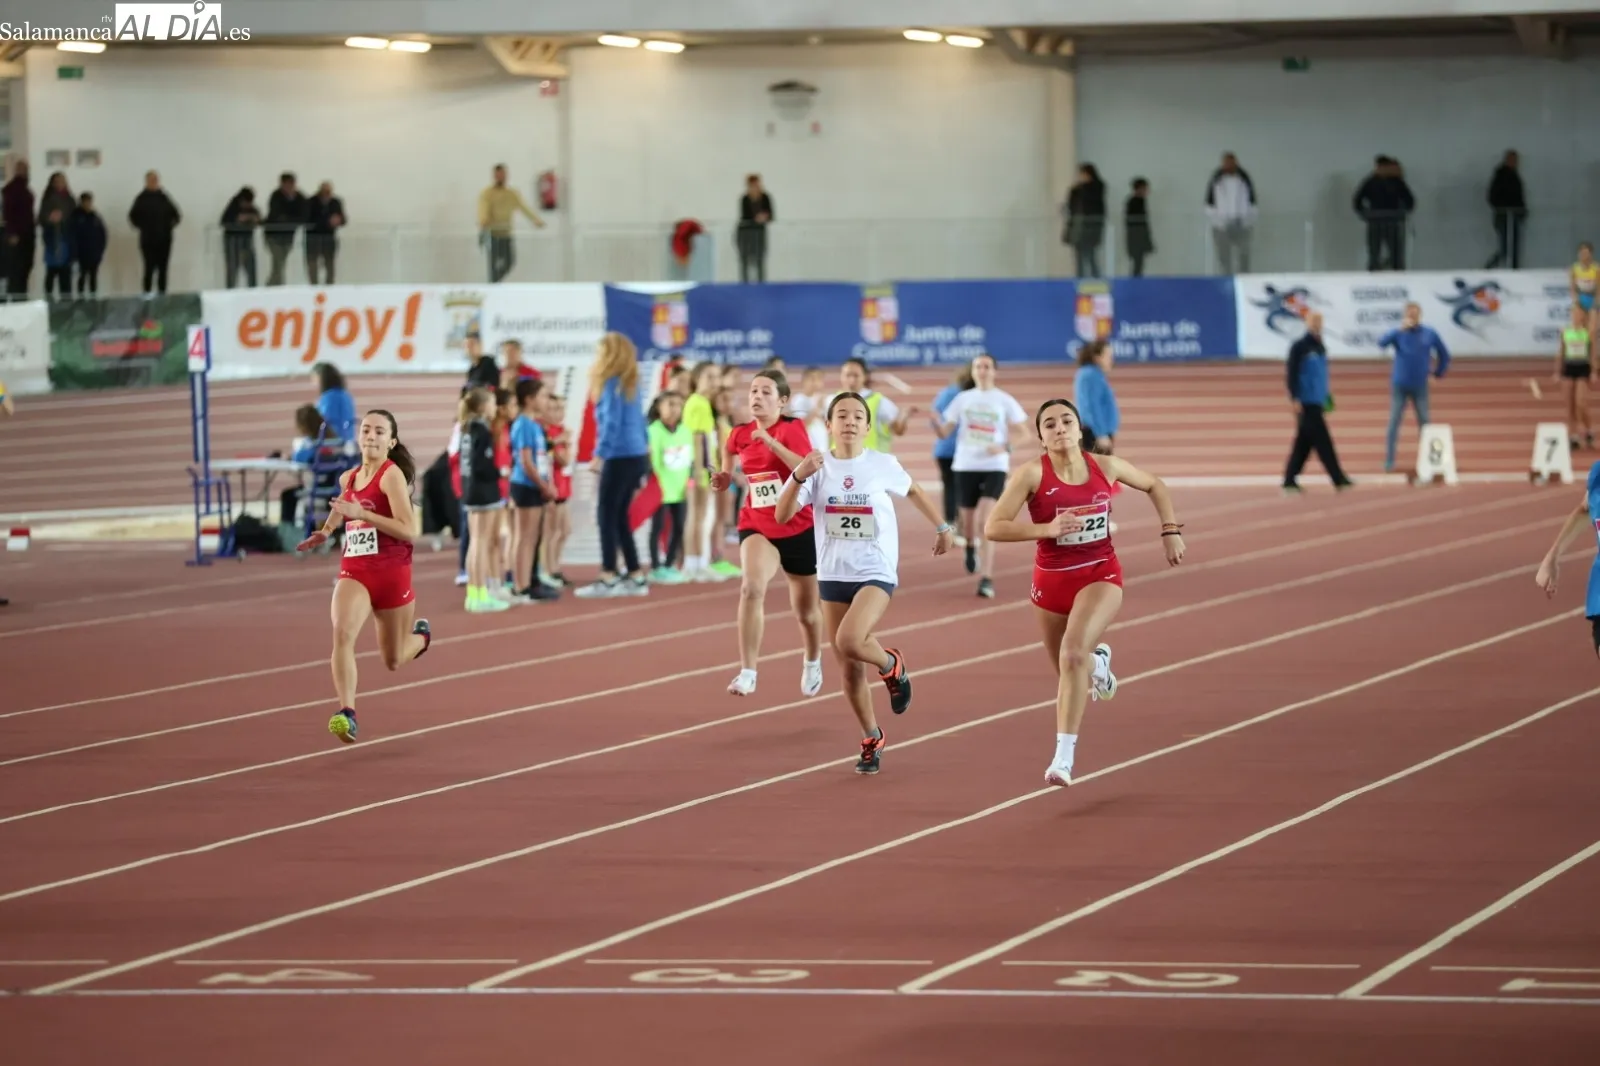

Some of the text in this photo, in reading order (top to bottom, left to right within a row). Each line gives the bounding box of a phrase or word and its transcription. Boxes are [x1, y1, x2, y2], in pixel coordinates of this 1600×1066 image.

[237, 292, 423, 362] enjoy!
[904, 324, 987, 343] Junta de
[1117, 318, 1201, 338] Junta de
[188, 328, 206, 357] 4
[694, 328, 774, 347] Junta de
[1153, 339, 1202, 358] León
[1544, 437, 1558, 464] 7
[755, 484, 777, 498] 601
[840, 516, 861, 529] 26
[348, 531, 375, 545] 1024
